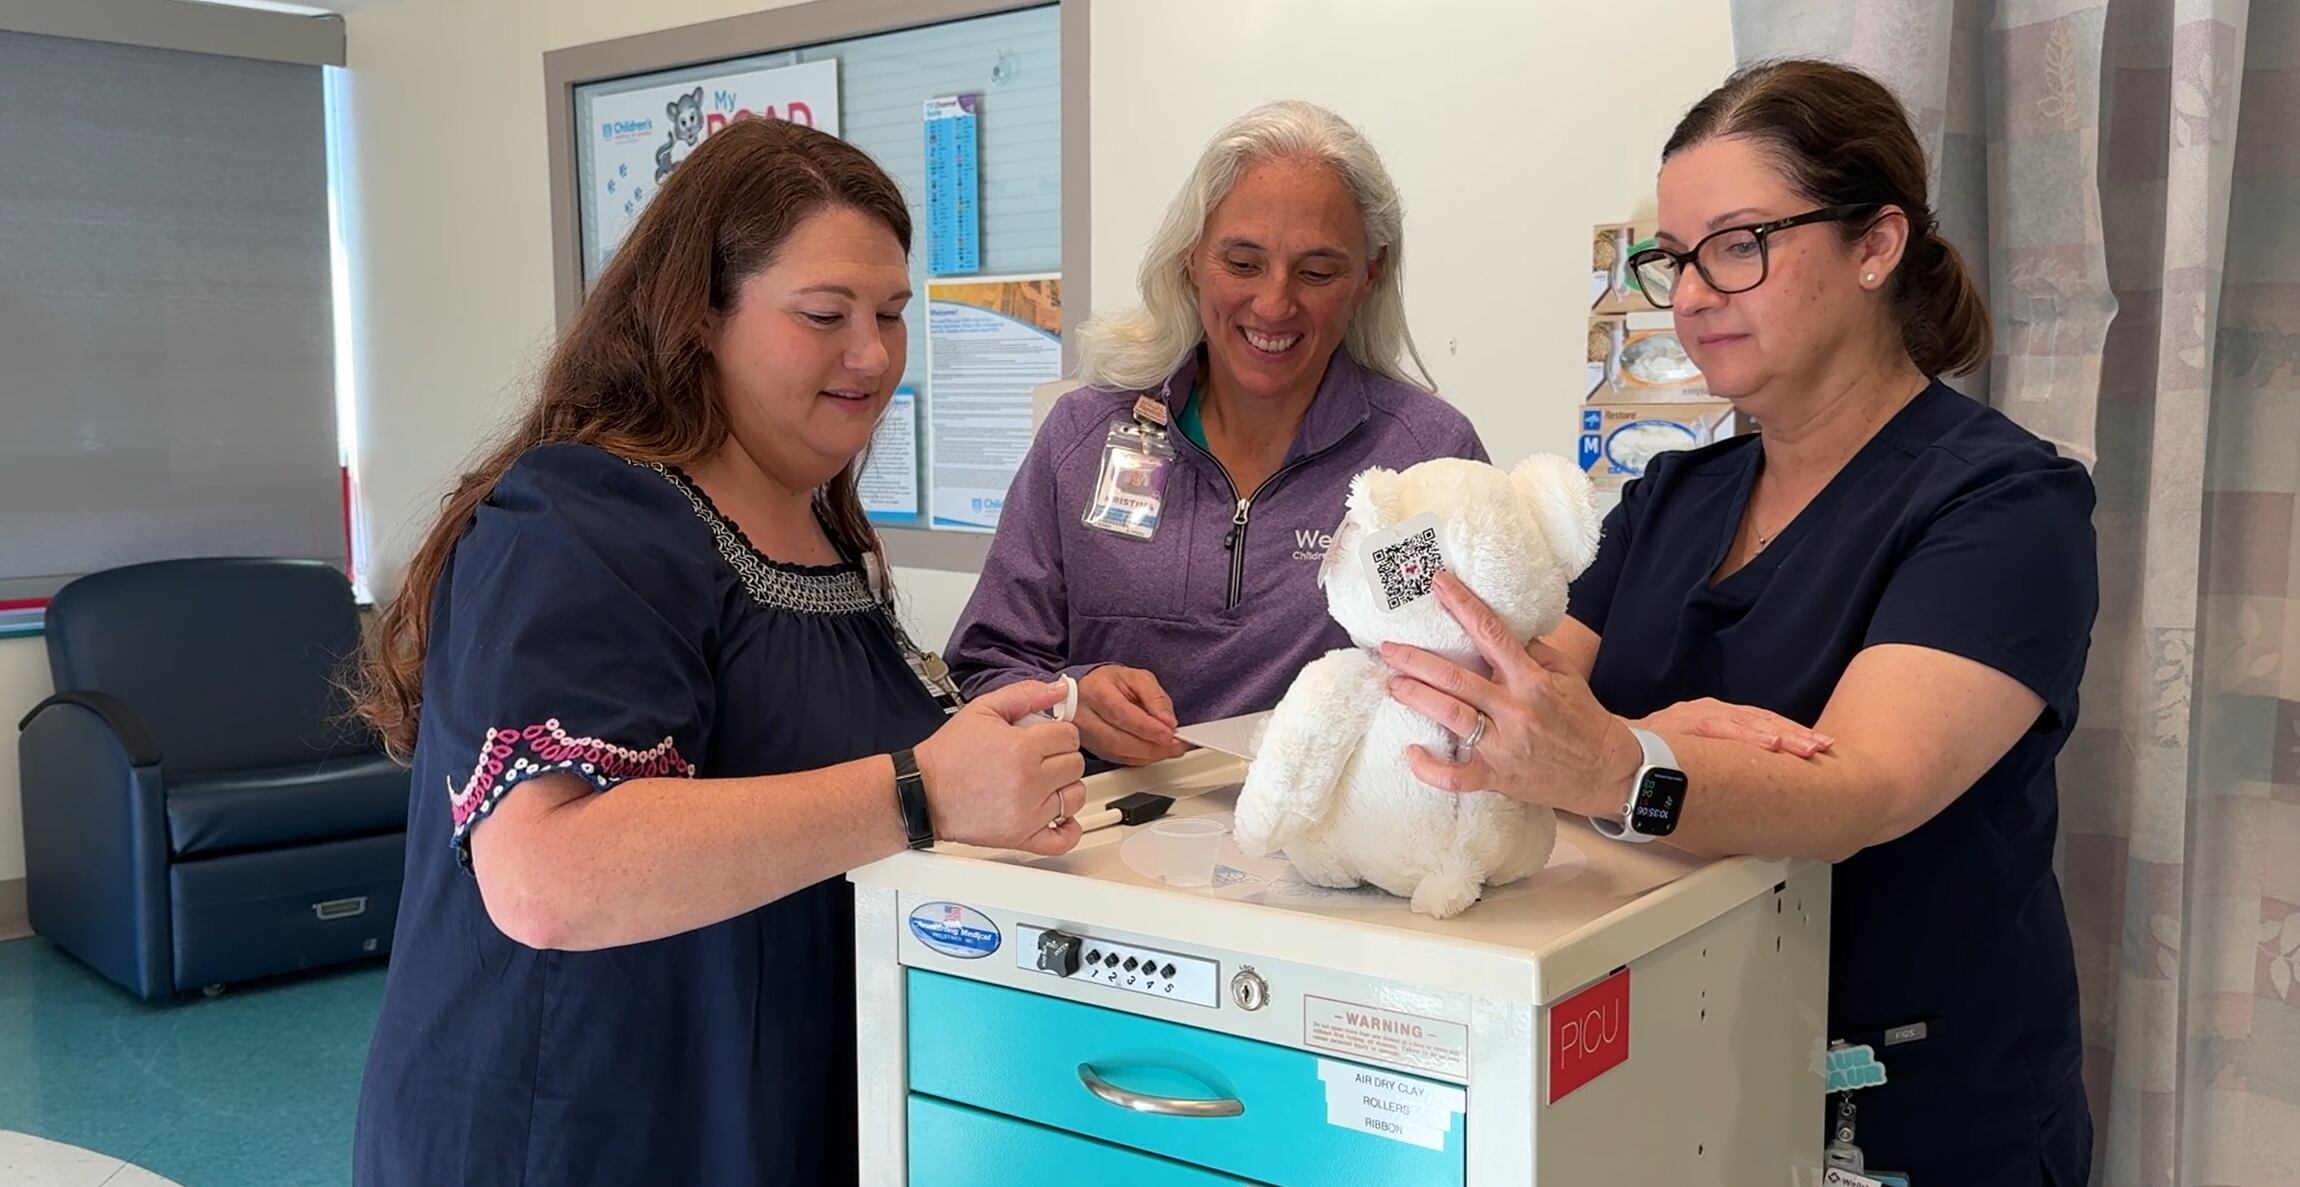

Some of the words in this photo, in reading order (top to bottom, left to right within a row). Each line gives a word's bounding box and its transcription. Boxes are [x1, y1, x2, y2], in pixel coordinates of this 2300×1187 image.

[715, 91, 737, 112] My
[1605, 411, 1636, 420] Restore
[1584, 437, 1599, 454] M
[1090, 969, 1099, 979] 1
[1108, 972, 1118, 982] 2
[1126, 975, 1136, 986] 3
[1146, 980, 1155, 989] 4
[1164, 982, 1174, 993] 5
[1345, 1012, 1423, 1039] WARNING
[1561, 998, 1619, 1070] PICU
[1355, 1073, 1373, 1086] AIR
[1374, 1077, 1395, 1090] DRY
[1397, 1082, 1425, 1097] CLAY
[1363, 1096, 1410, 1116] ROLLERS
[1365, 1117, 1403, 1135] RIBBON
